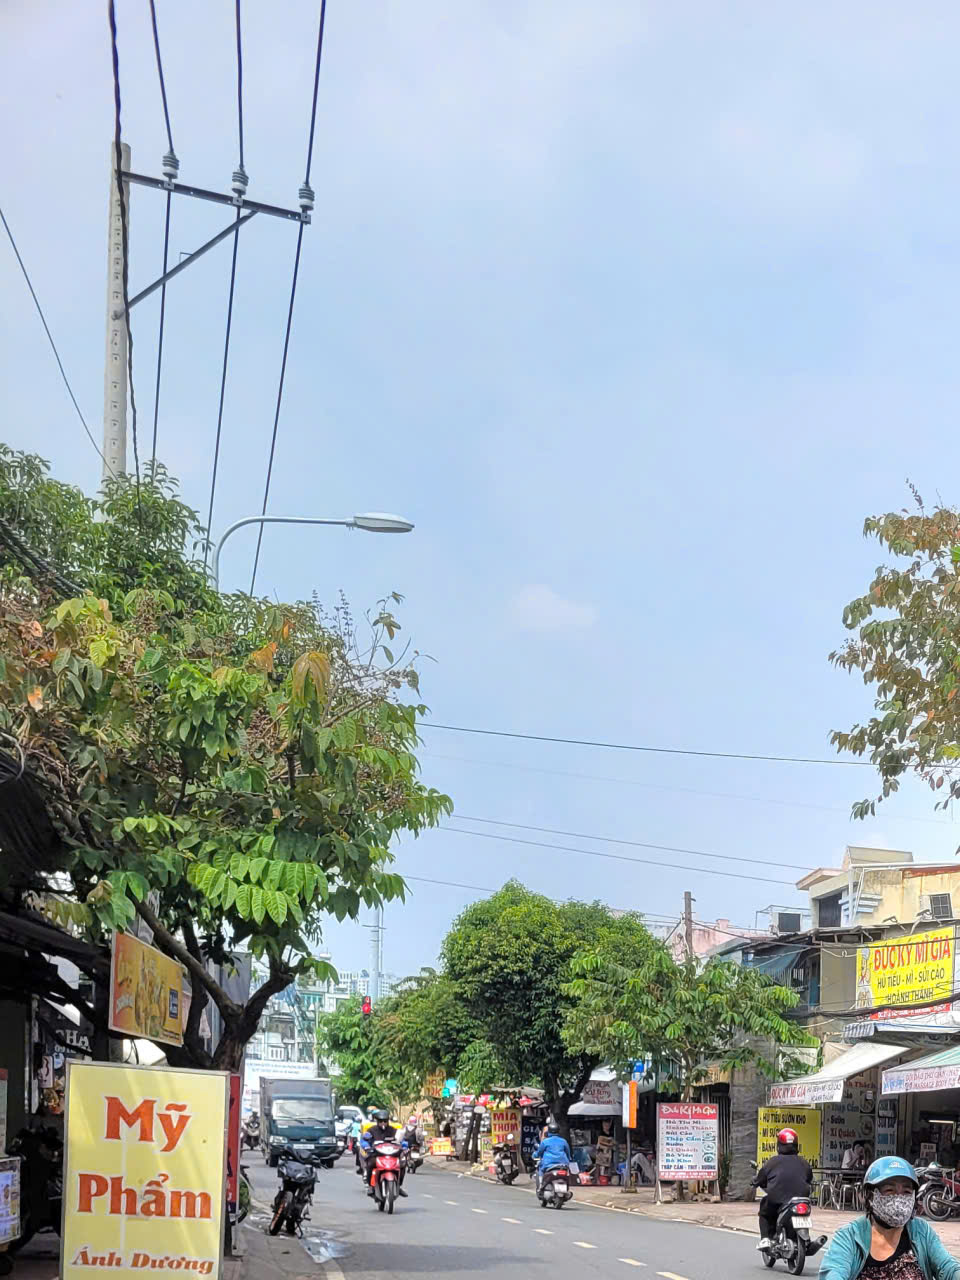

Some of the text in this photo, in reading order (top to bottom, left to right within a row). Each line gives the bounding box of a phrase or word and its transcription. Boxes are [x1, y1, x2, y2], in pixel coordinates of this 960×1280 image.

[104, 1095, 192, 1152] Mỹ
[77, 1172, 213, 1220] Phẩm
[72, 1245, 215, 1276] Ánh Dương
